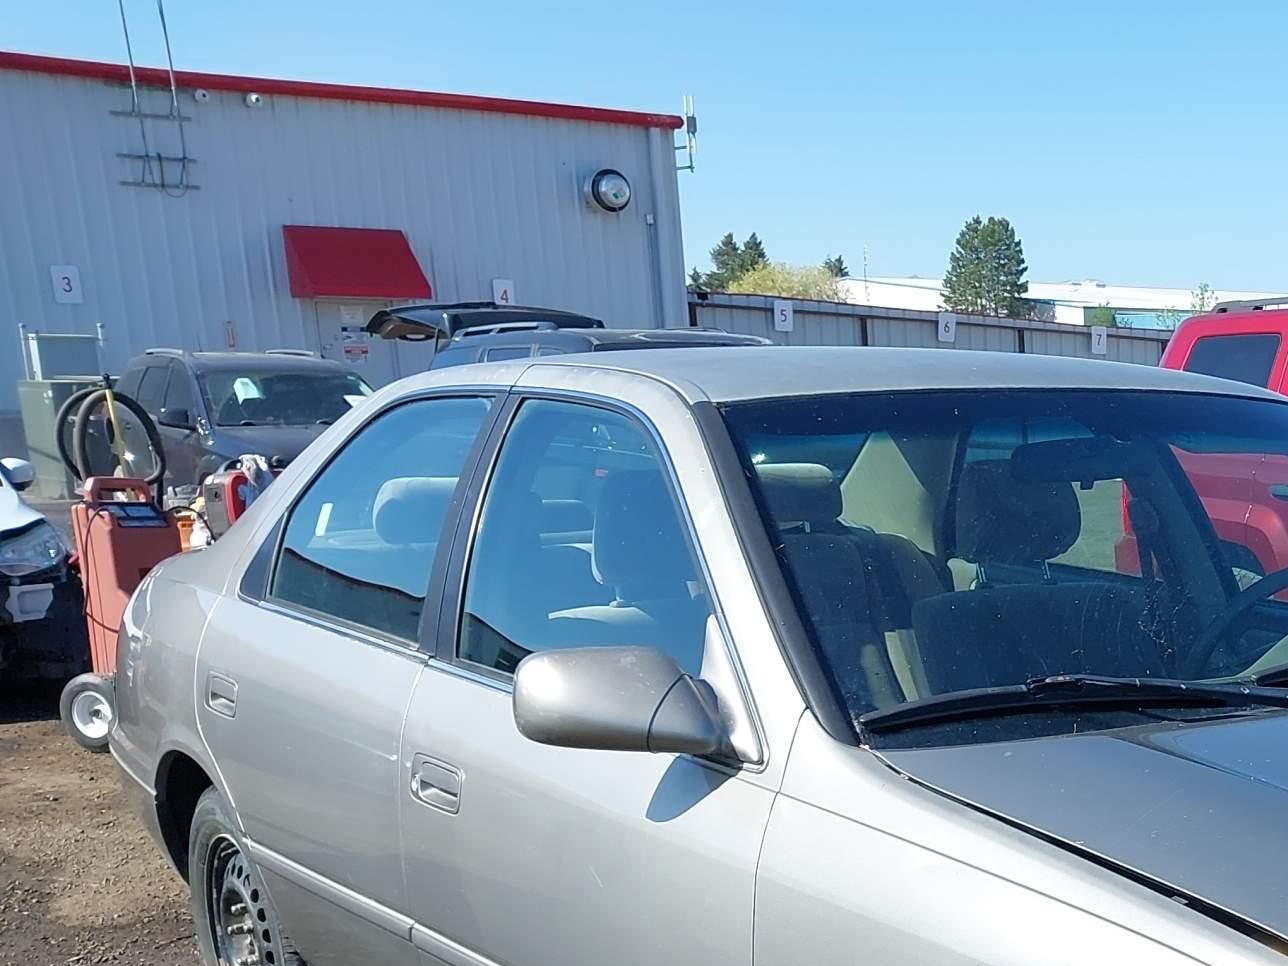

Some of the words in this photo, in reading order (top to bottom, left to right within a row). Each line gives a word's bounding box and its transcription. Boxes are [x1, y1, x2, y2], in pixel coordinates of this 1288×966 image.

[62, 276, 73, 293] 3
[500, 288, 509, 304] 4
[780, 308, 788, 323] 5
[943, 320, 951, 334] 6
[1095, 333, 1103, 346] 7
